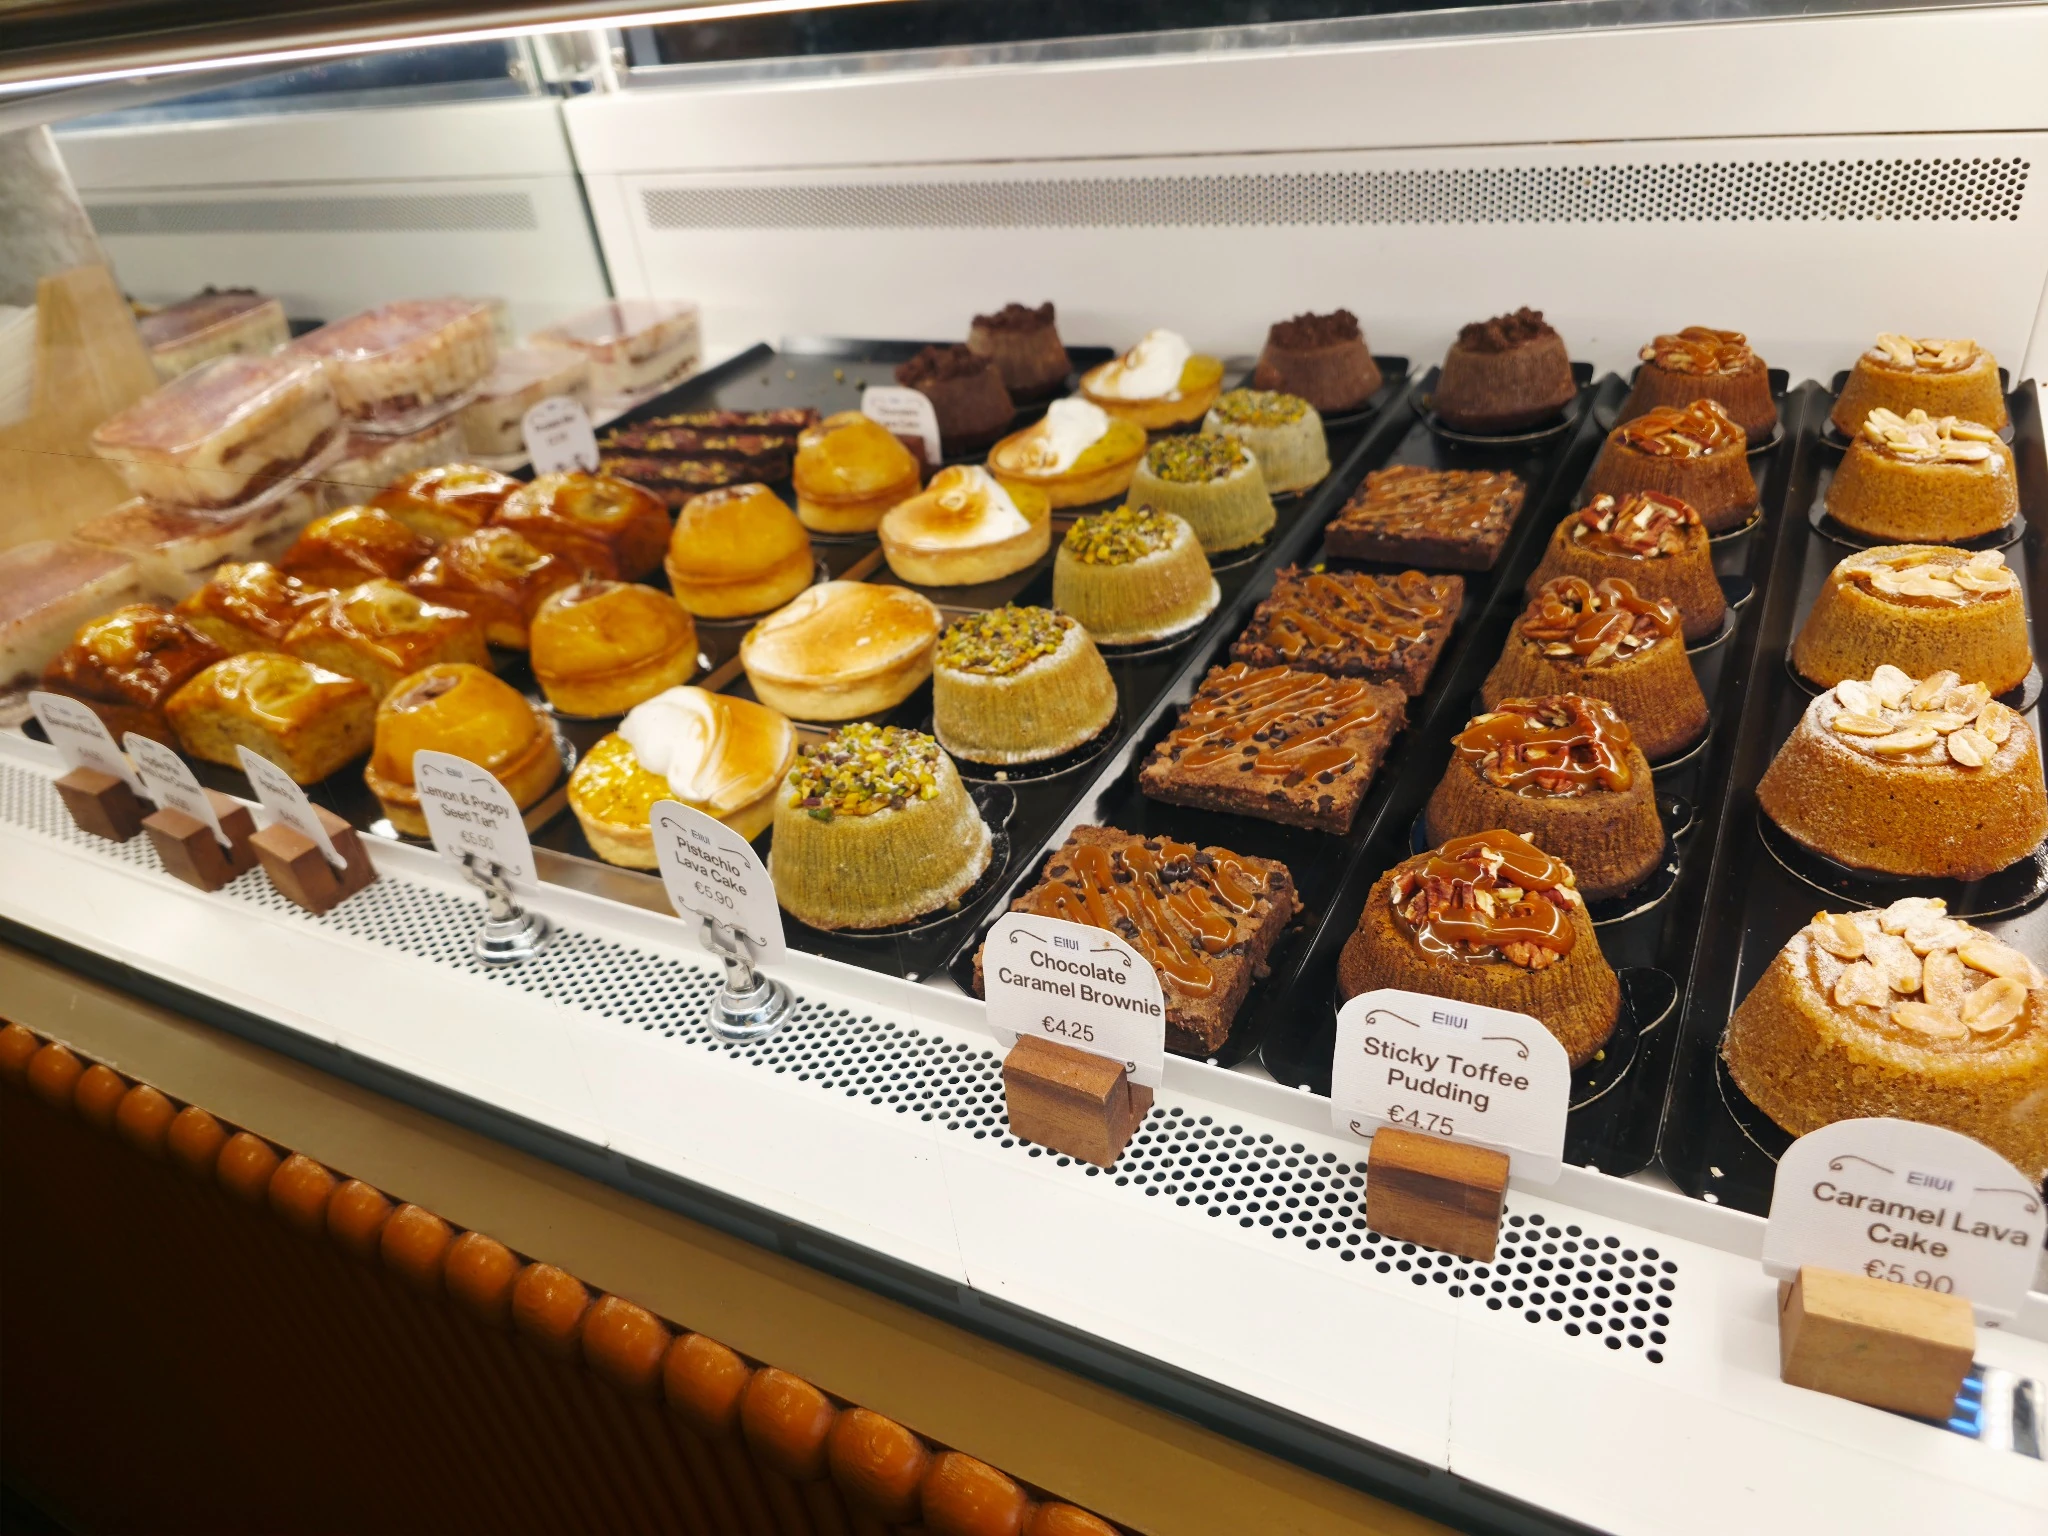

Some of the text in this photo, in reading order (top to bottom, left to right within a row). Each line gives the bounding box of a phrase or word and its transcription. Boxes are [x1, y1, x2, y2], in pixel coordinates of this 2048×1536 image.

[420, 781, 509, 819] Lemon & Poppy
[675, 851, 747, 896] Lava Cake
[676, 835, 740, 876] Pistachio
[694, 881, 734, 909] €5.90
[1030, 950, 1126, 984] Chocolate
[998, 967, 1161, 1017] Caramel Brownie
[1042, 1016, 1094, 1042] €4.25
[1364, 1036, 1529, 1091] Sticky Toffee
[1387, 1068, 1490, 1112] Pudding
[1387, 1105, 1454, 1136] €4.75
[1813, 1181, 2029, 1247] Caramel Lava
[1867, 1223, 1948, 1258] Cake
[1863, 1259, 1954, 1294] €590
